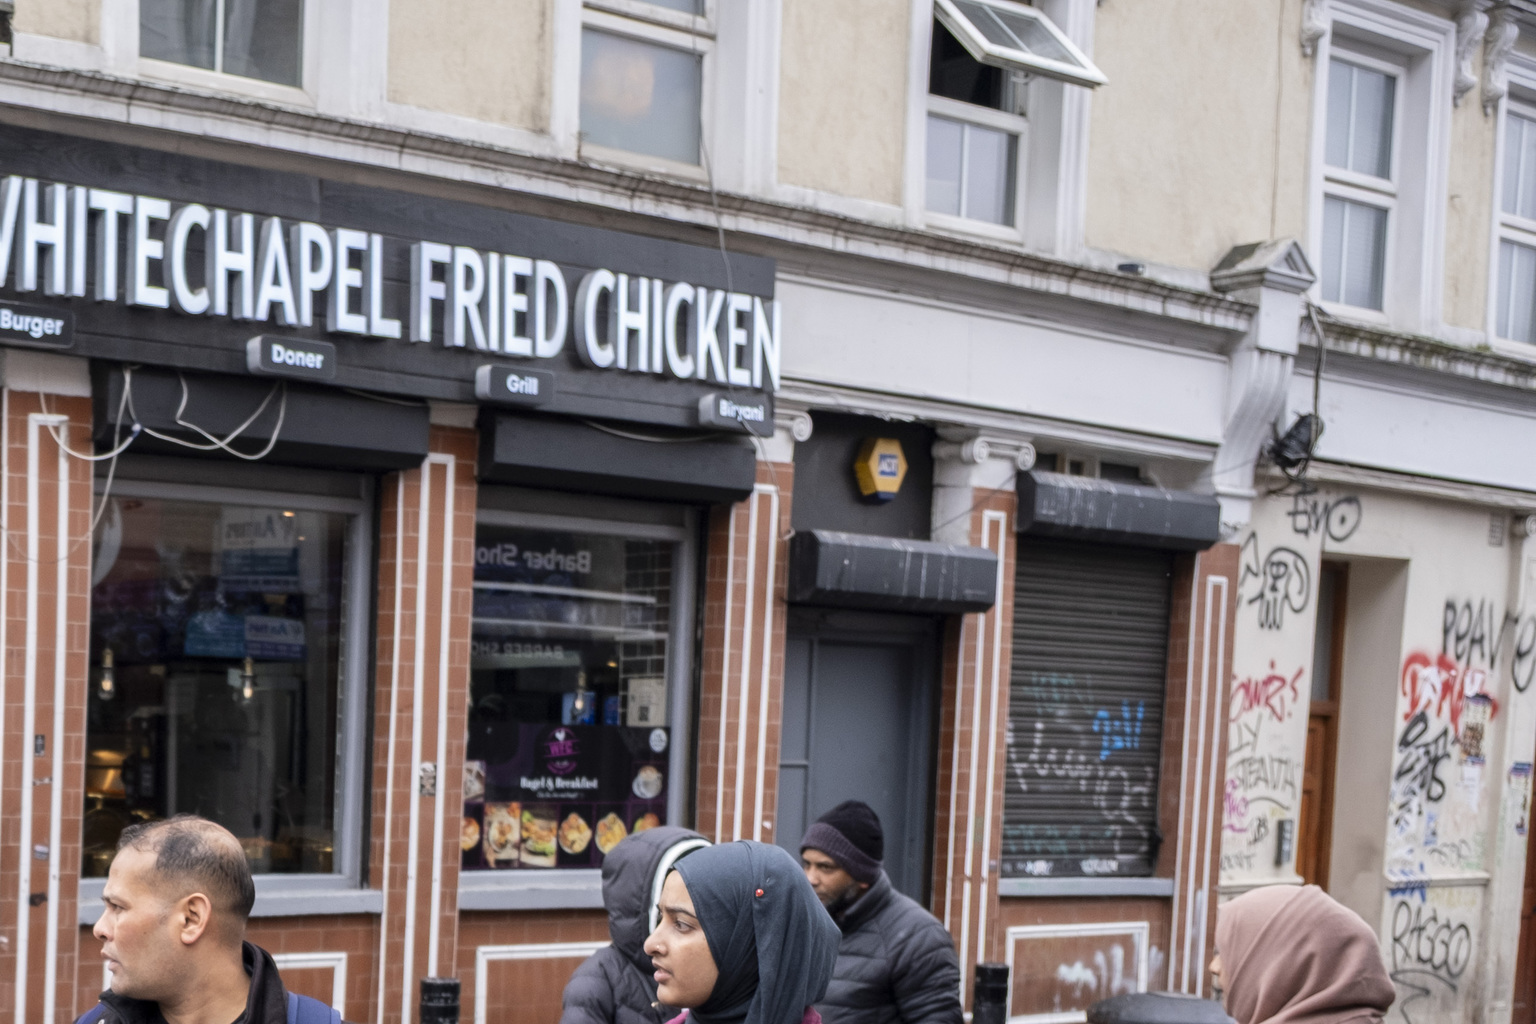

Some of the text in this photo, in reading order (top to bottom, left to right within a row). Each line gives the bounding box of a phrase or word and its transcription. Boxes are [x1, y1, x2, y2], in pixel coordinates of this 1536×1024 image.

[416, 240, 568, 359] FRIED
[582, 267, 782, 391] CHICKEN
[271, 344, 324, 371] Doner
[506, 373, 539, 397] Grill
[719, 398, 765, 423] Biryani
[555, 775, 599, 790] Breakfast
